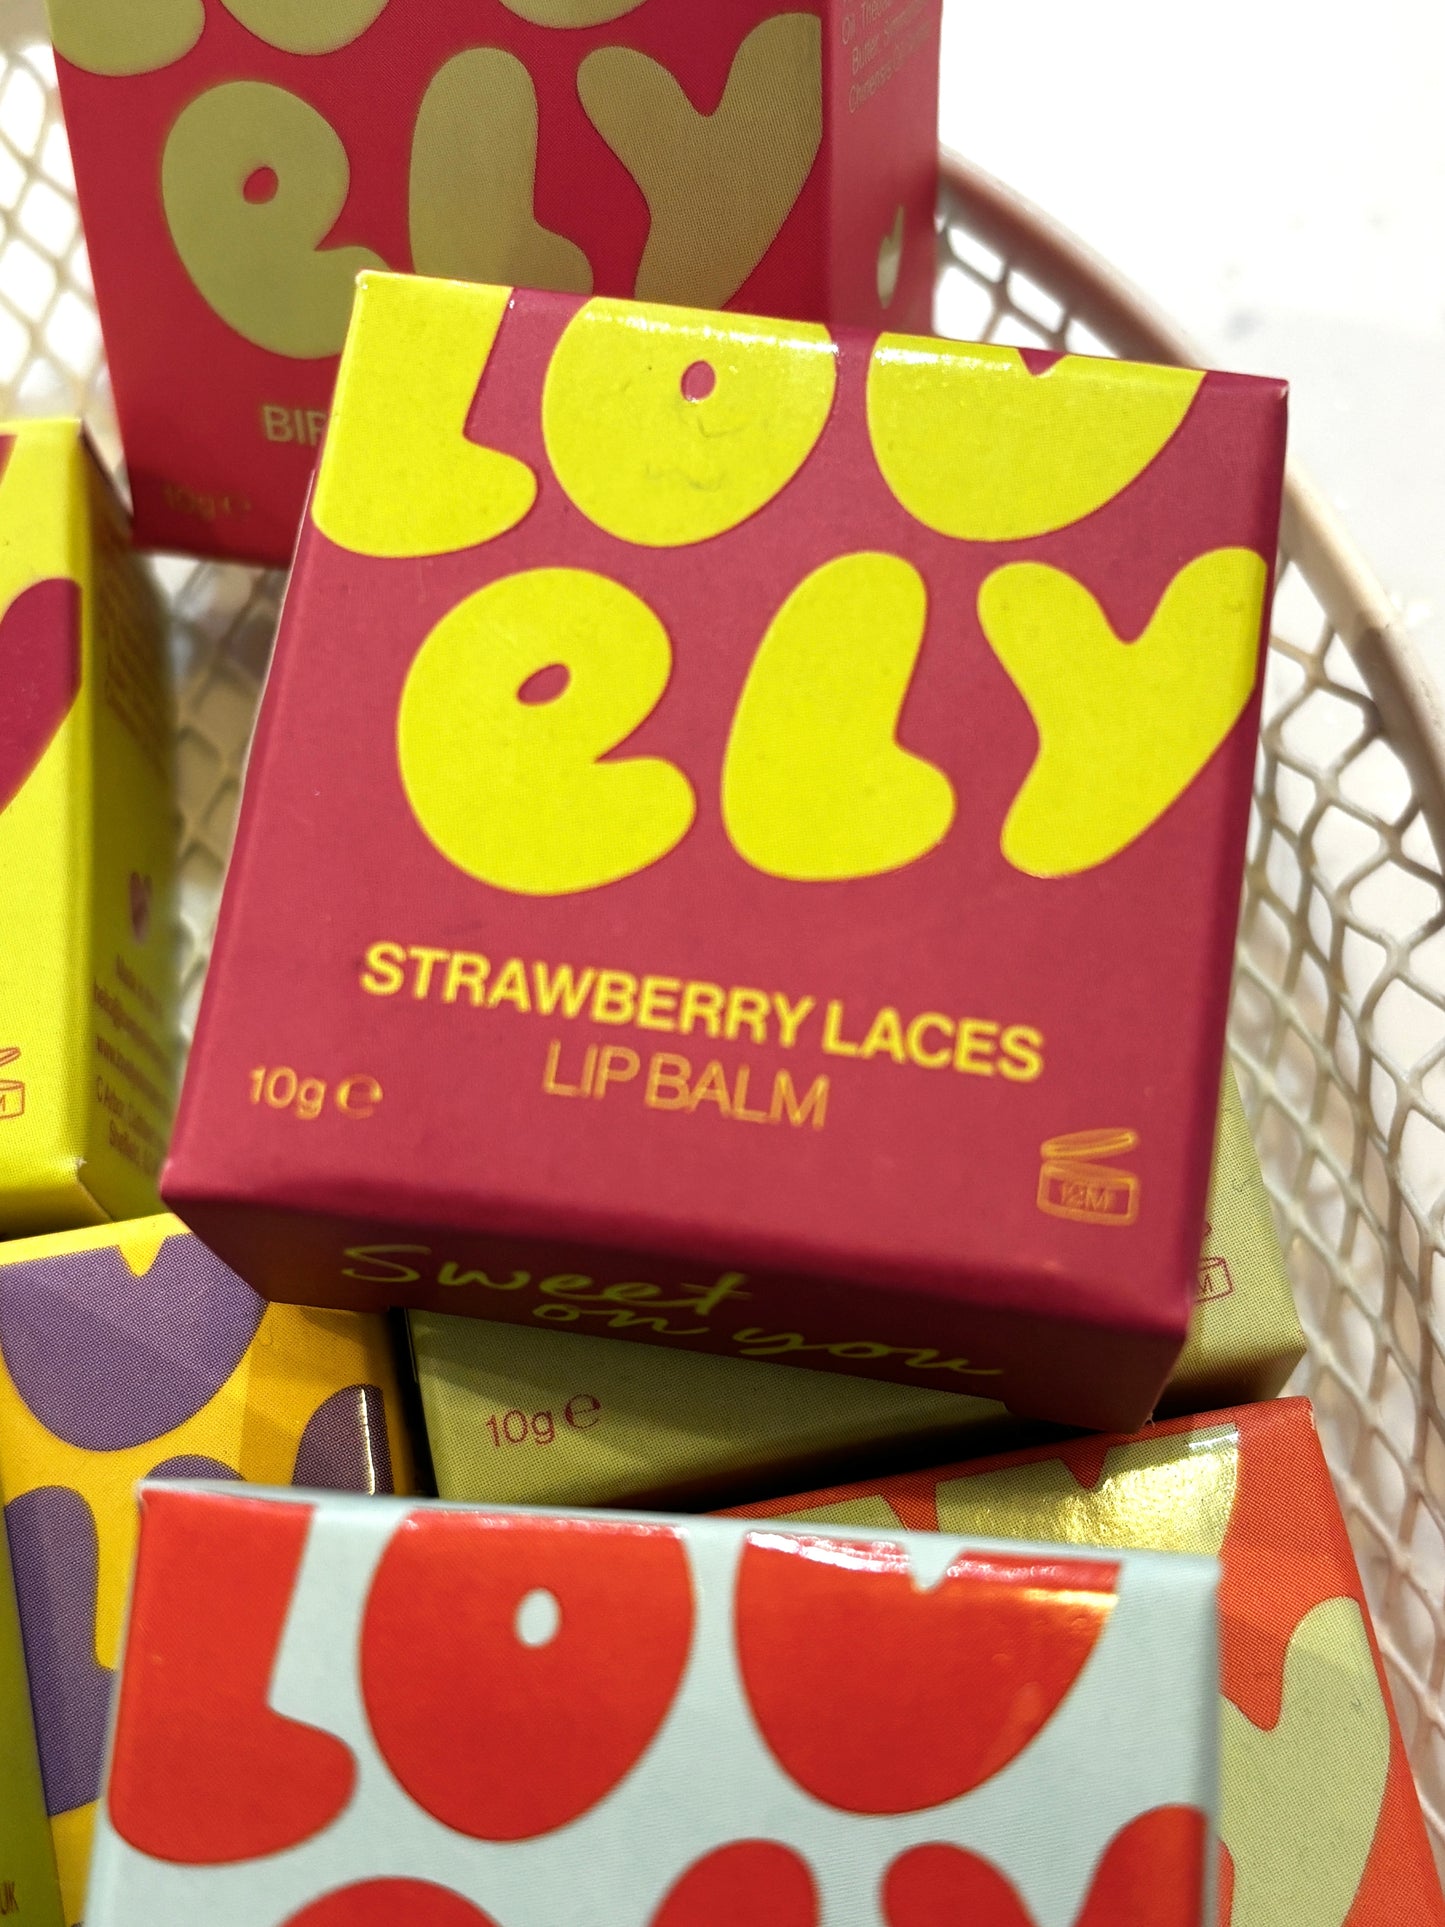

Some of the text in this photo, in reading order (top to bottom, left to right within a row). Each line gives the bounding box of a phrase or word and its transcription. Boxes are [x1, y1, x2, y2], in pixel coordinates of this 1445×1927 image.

[360, 940, 1045, 1084] STRAWBERRY LACES
[249, 1064, 326, 1120] 10g
[542, 1038, 830, 1131] LIP BALM
[342, 1243, 751, 1316] Sweet
[532, 1303, 1004, 1376] on you
[485, 1407, 556, 1447] 10g
